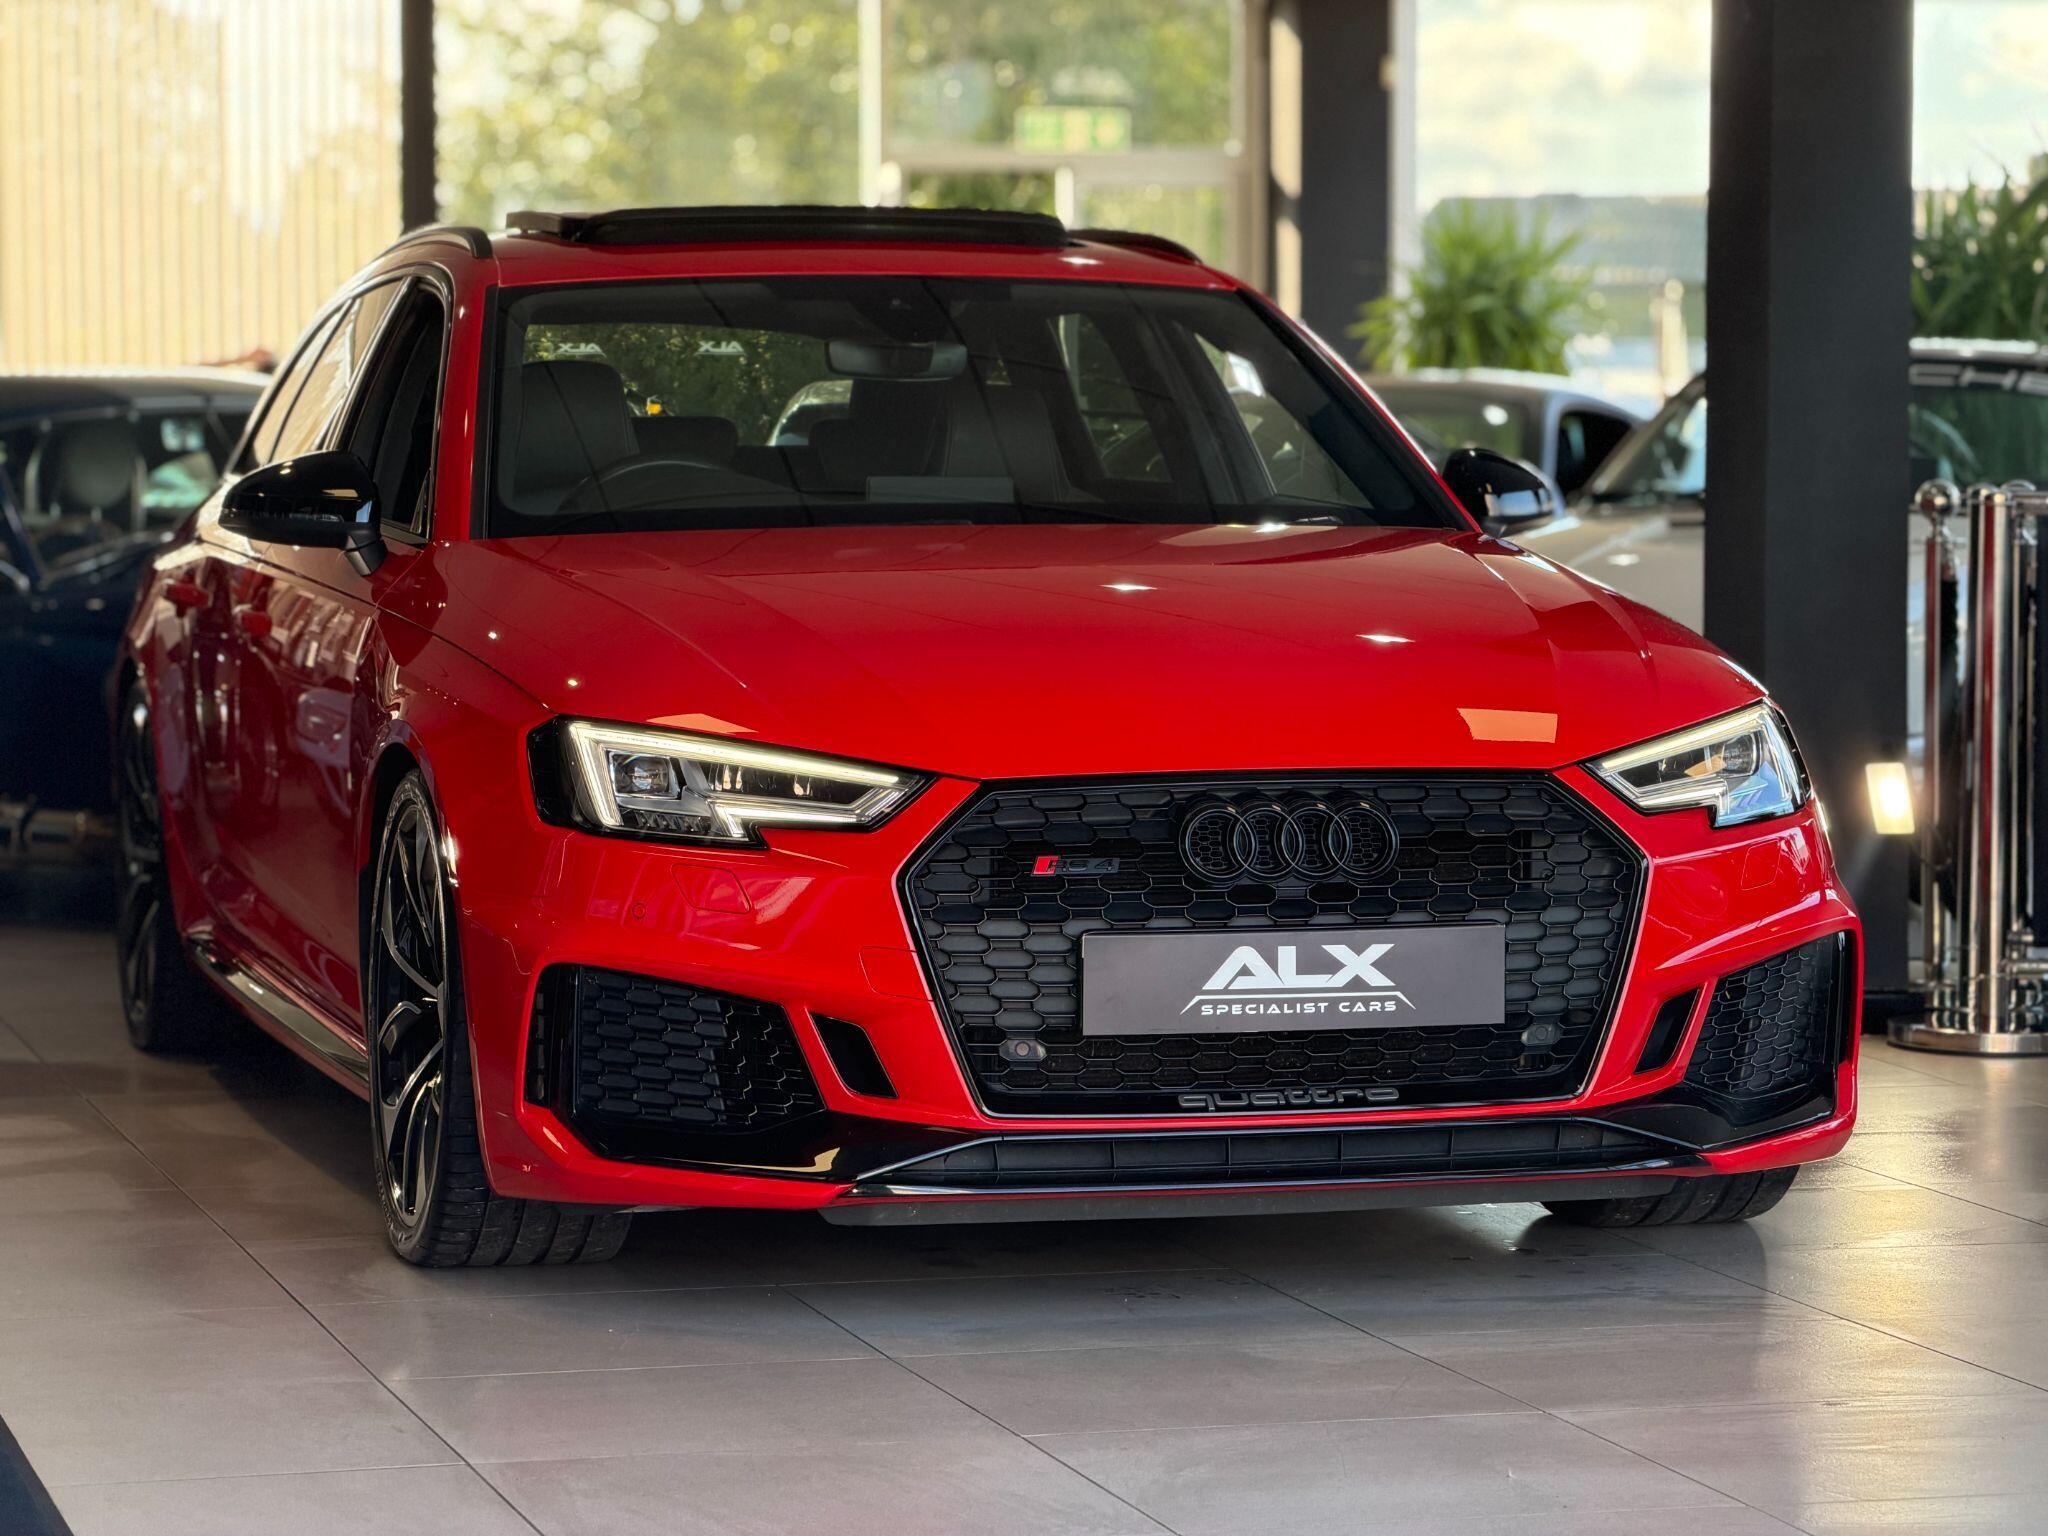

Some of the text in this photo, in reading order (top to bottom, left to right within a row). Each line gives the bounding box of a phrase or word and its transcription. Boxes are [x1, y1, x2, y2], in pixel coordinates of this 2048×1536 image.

[1202, 943, 1396, 990] ALX
[1201, 1001, 1397, 1016] SPECIALIST CARS
[1178, 1087, 1400, 1112] quattro
